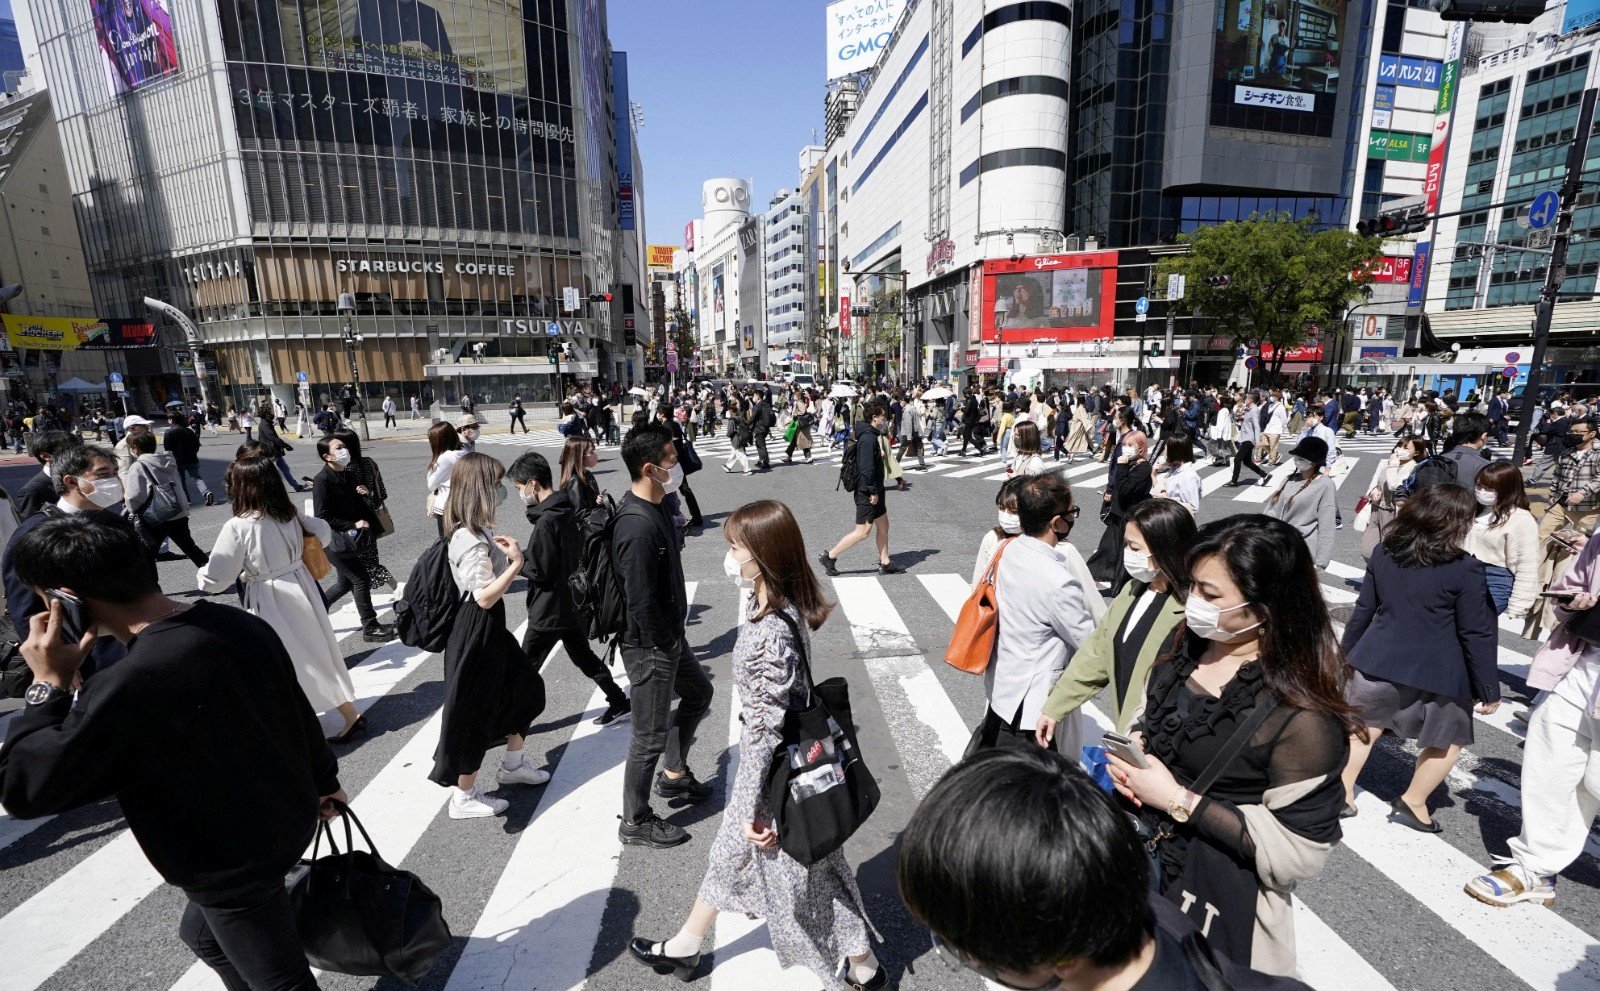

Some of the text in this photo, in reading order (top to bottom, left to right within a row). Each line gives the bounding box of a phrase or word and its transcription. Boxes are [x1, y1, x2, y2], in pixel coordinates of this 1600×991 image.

[838, 13, 893, 39] インターネット
[838, 32, 894, 61] GMO
[1444, 64, 1454, 82] レイク
[1369, 137, 1408, 149] レイク ALSA
[1417, 143, 1428, 153] 5F
[1427, 163, 1440, 192] アコム
[619, 171, 633, 218] SEIBU
[336, 259, 515, 276] STARBUCKS COFFEE
[1034, 258, 1062, 269] Glico
[1397, 259, 1409, 268] 3F
[1414, 253, 1426, 289] PROMISE
[806, 740, 821, 763] BAR
